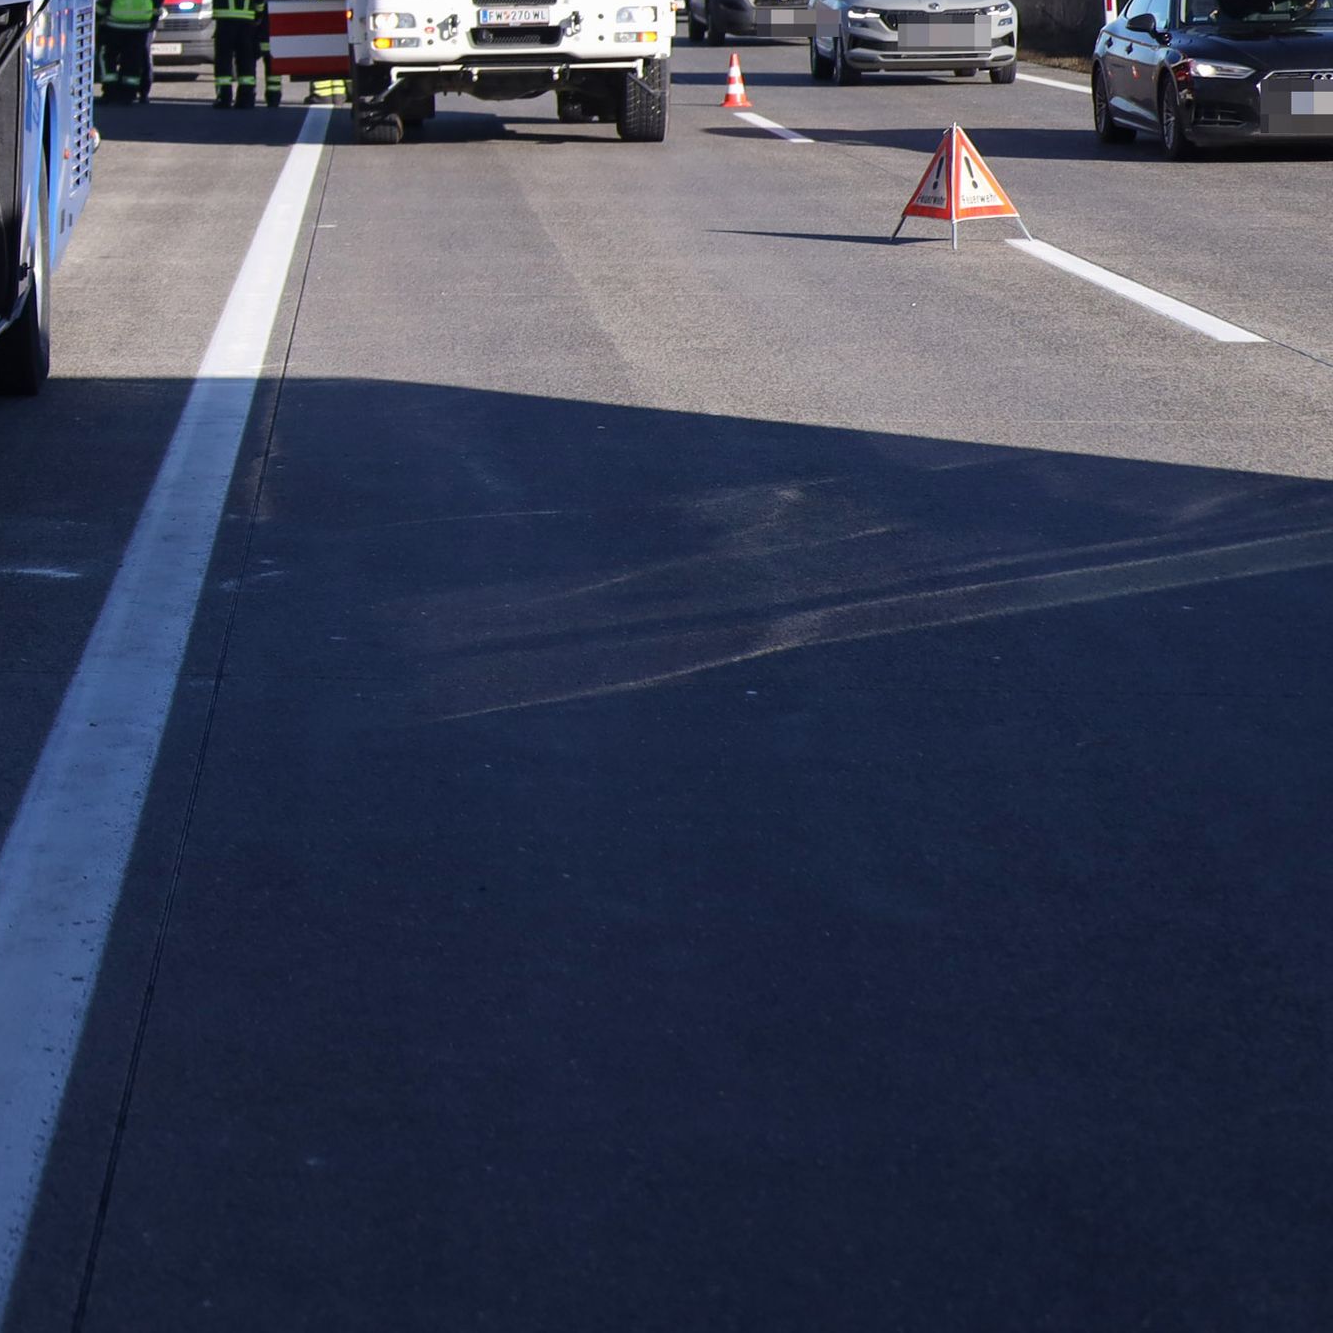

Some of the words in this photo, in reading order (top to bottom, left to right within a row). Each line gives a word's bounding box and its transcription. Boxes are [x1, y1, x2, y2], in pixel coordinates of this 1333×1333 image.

[488, 10, 503, 21] FW
[511, 9, 531, 21] 270
[533, 9, 546, 20] WL
